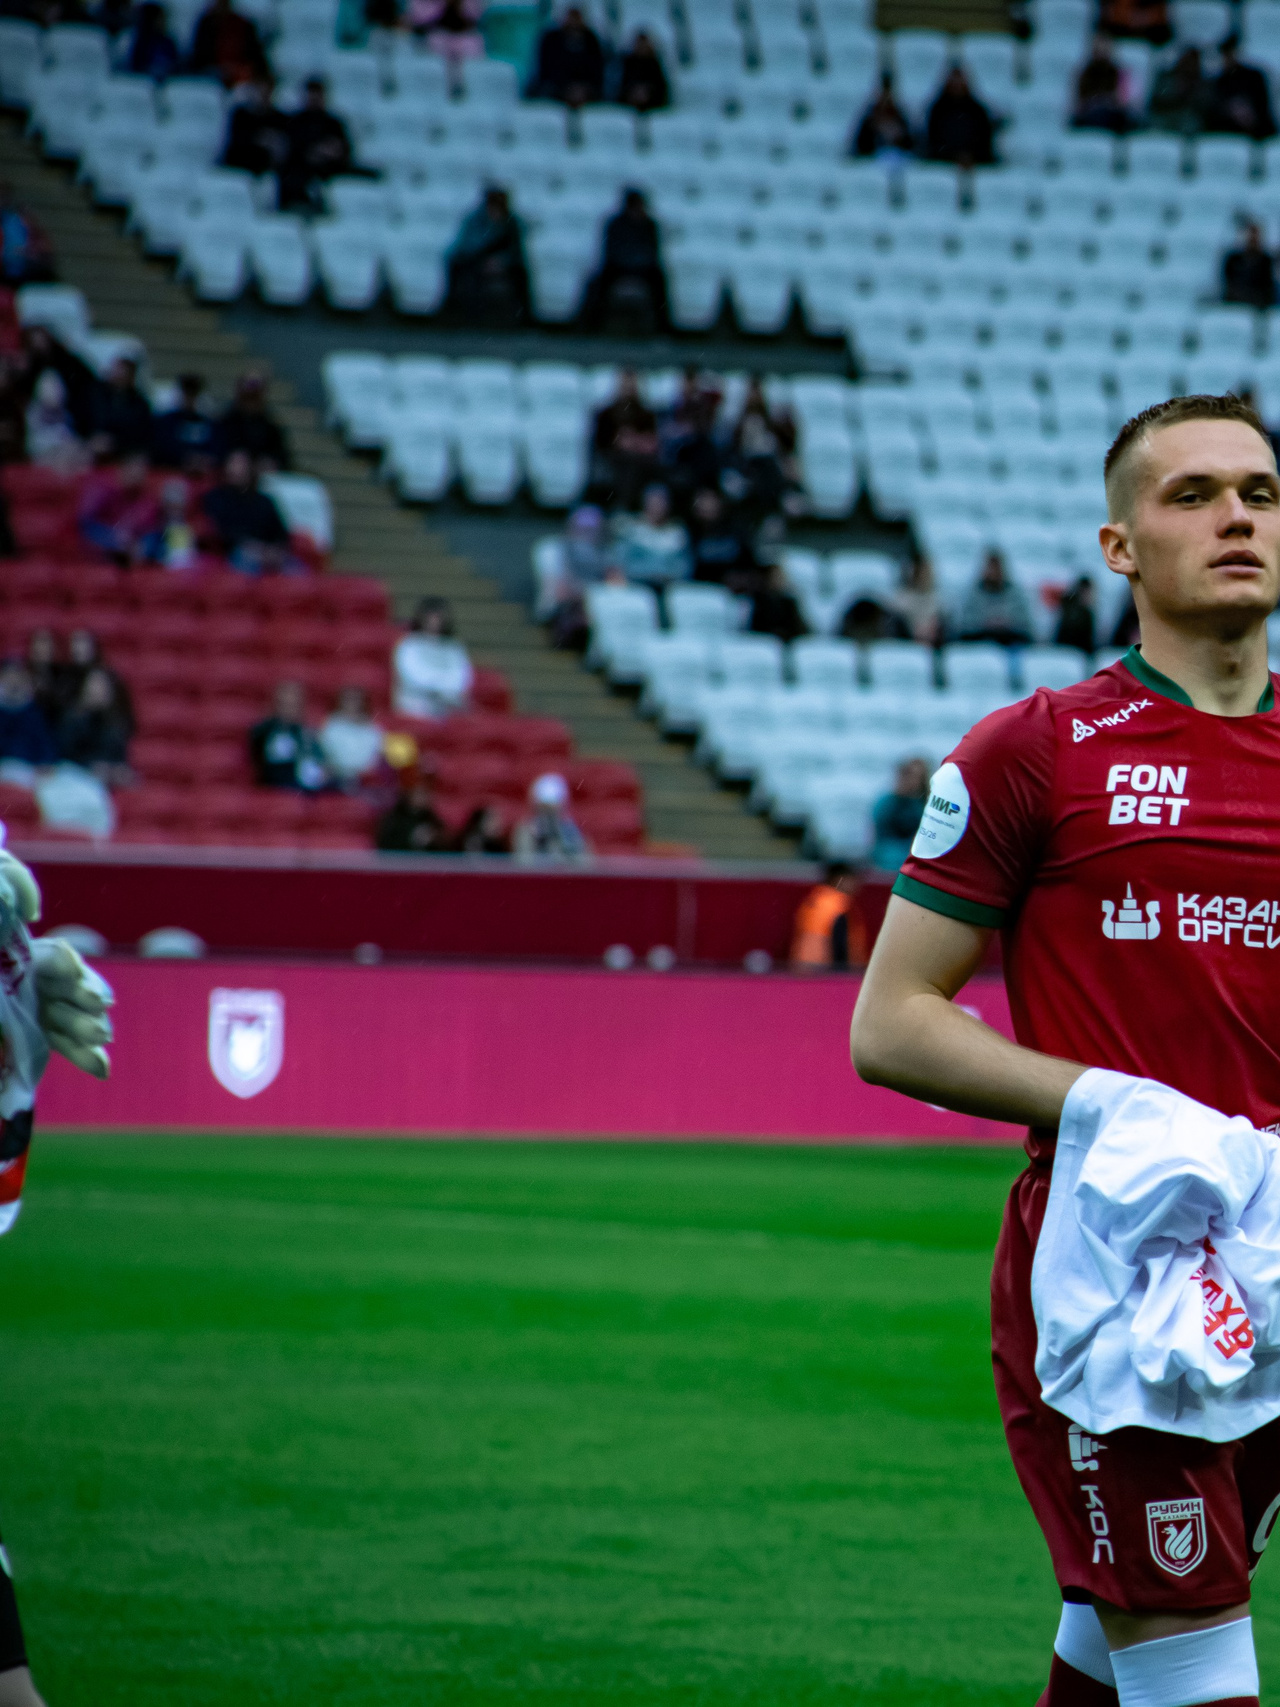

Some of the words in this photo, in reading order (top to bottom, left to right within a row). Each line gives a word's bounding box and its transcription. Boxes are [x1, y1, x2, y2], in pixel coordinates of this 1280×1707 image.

[1093, 698, 1155, 729] НКНХ
[1106, 764, 1188, 794] FON
[930, 795, 961, 816] МИР
[1108, 794, 1191, 827] BET
[1148, 1501, 1201, 1516] РУБИН
